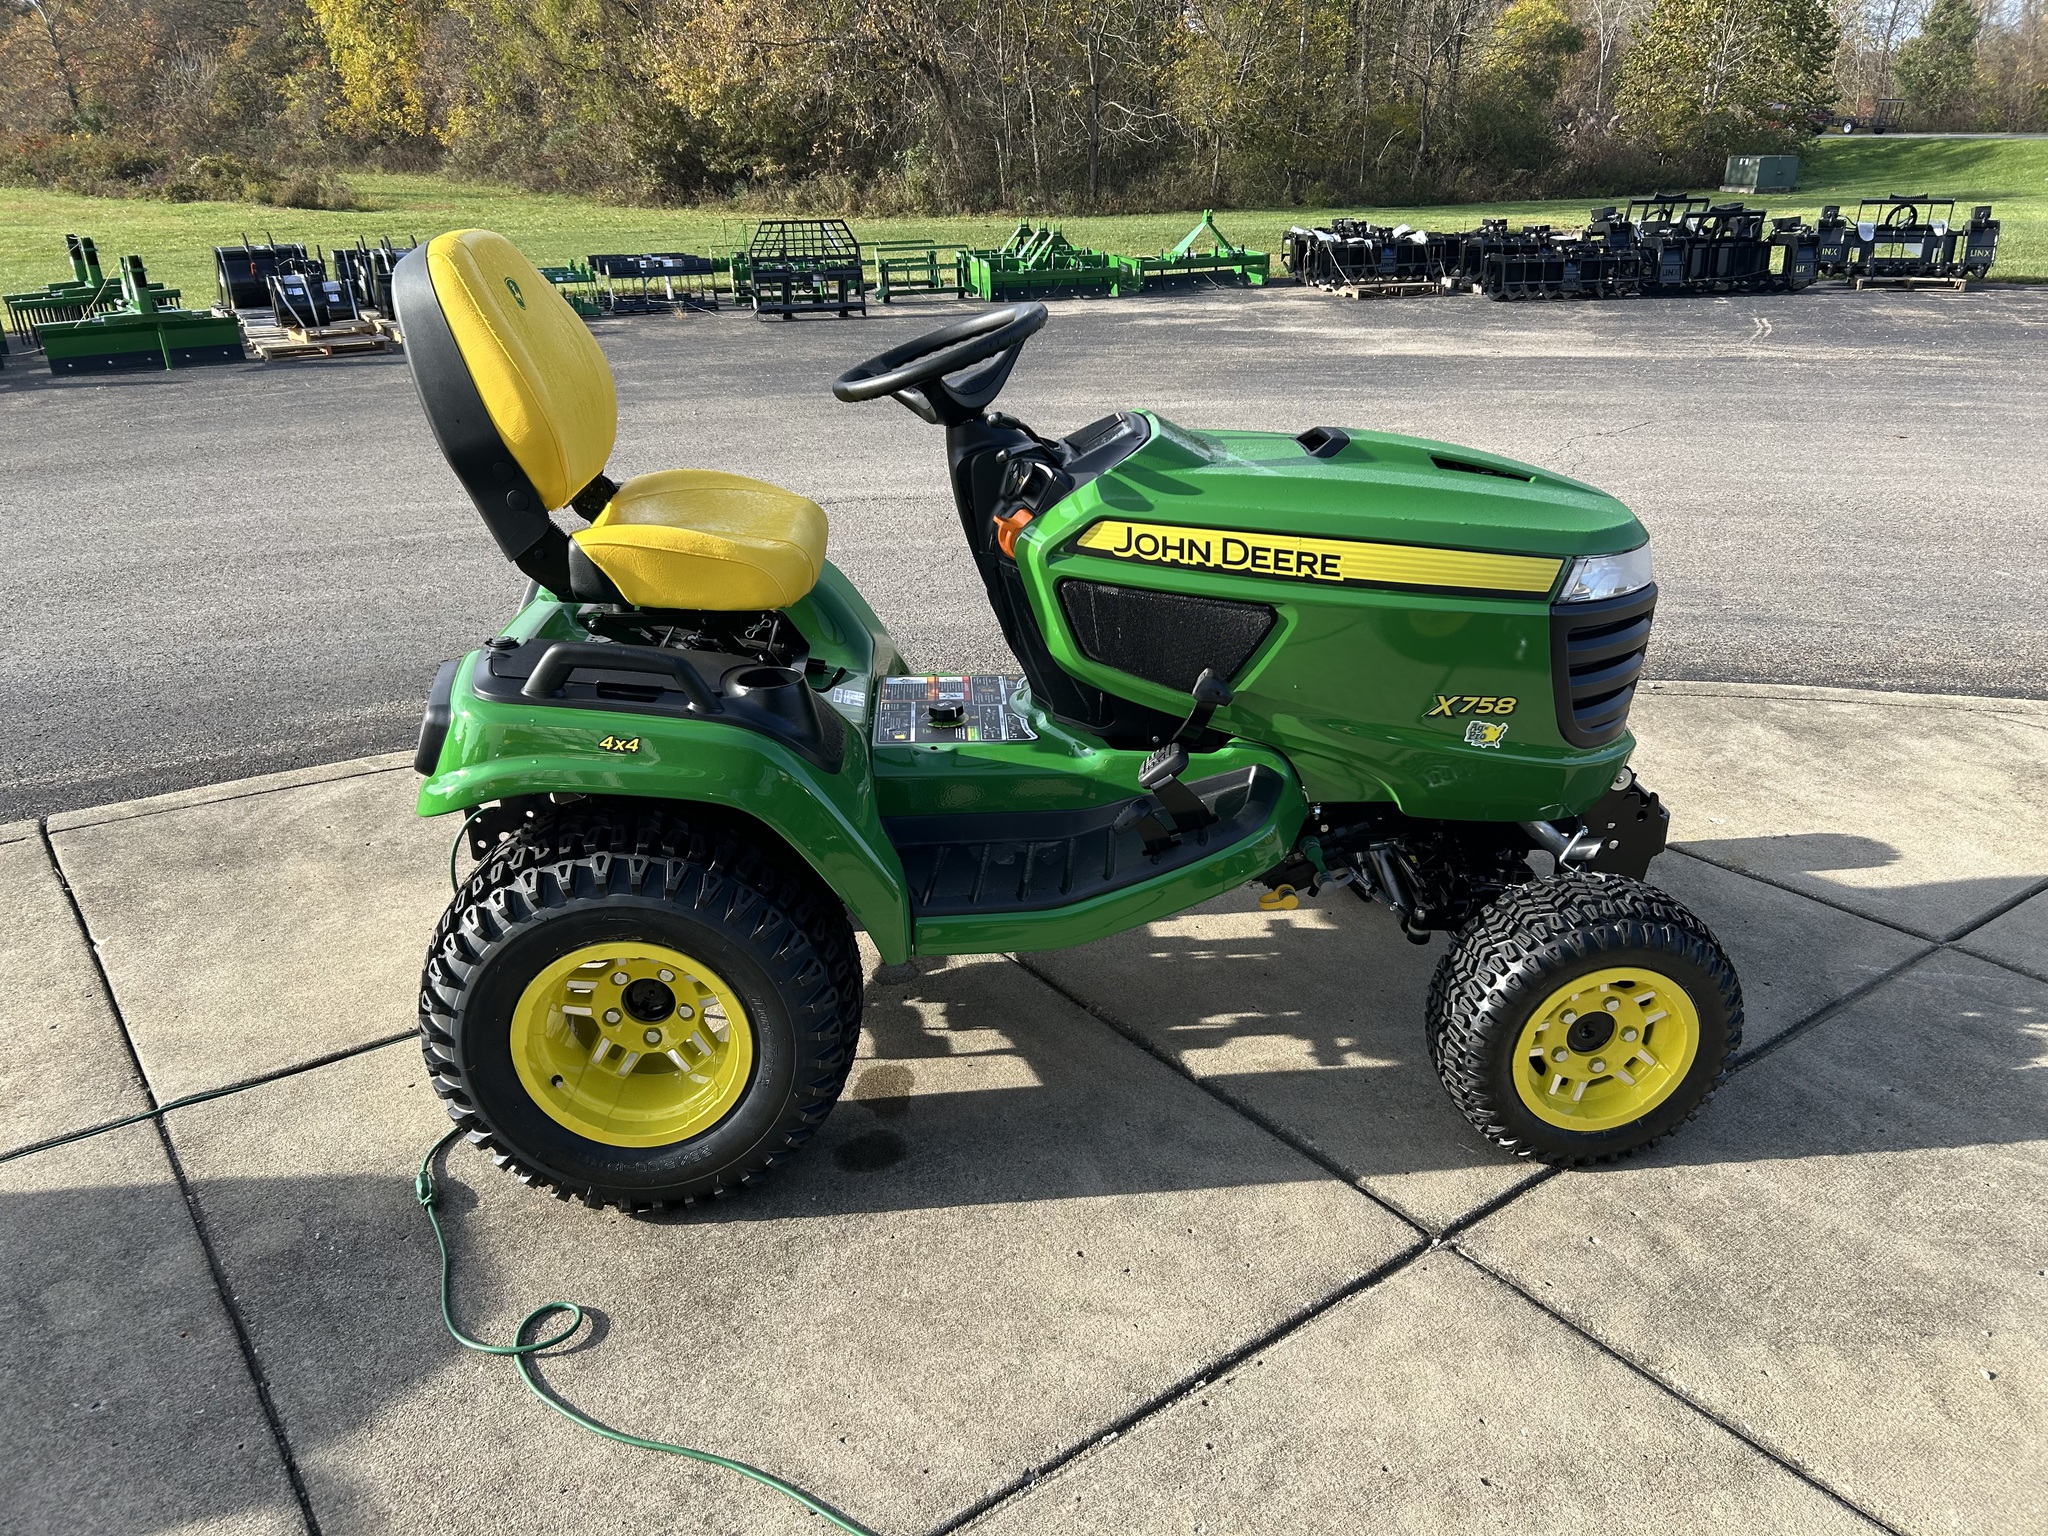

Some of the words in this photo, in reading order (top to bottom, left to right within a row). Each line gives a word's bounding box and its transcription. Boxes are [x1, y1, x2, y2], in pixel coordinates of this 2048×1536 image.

[1821, 247, 1838, 256] INX
[1970, 249, 1991, 257] LINX
[1662, 268, 1679, 277] LINX
[1114, 526, 1212, 564] JOHN
[1222, 537, 1342, 578] DEERE
[1427, 695, 1518, 717] X758
[1467, 731, 1486, 740] Pro
[599, 735, 640, 753] 4x4
